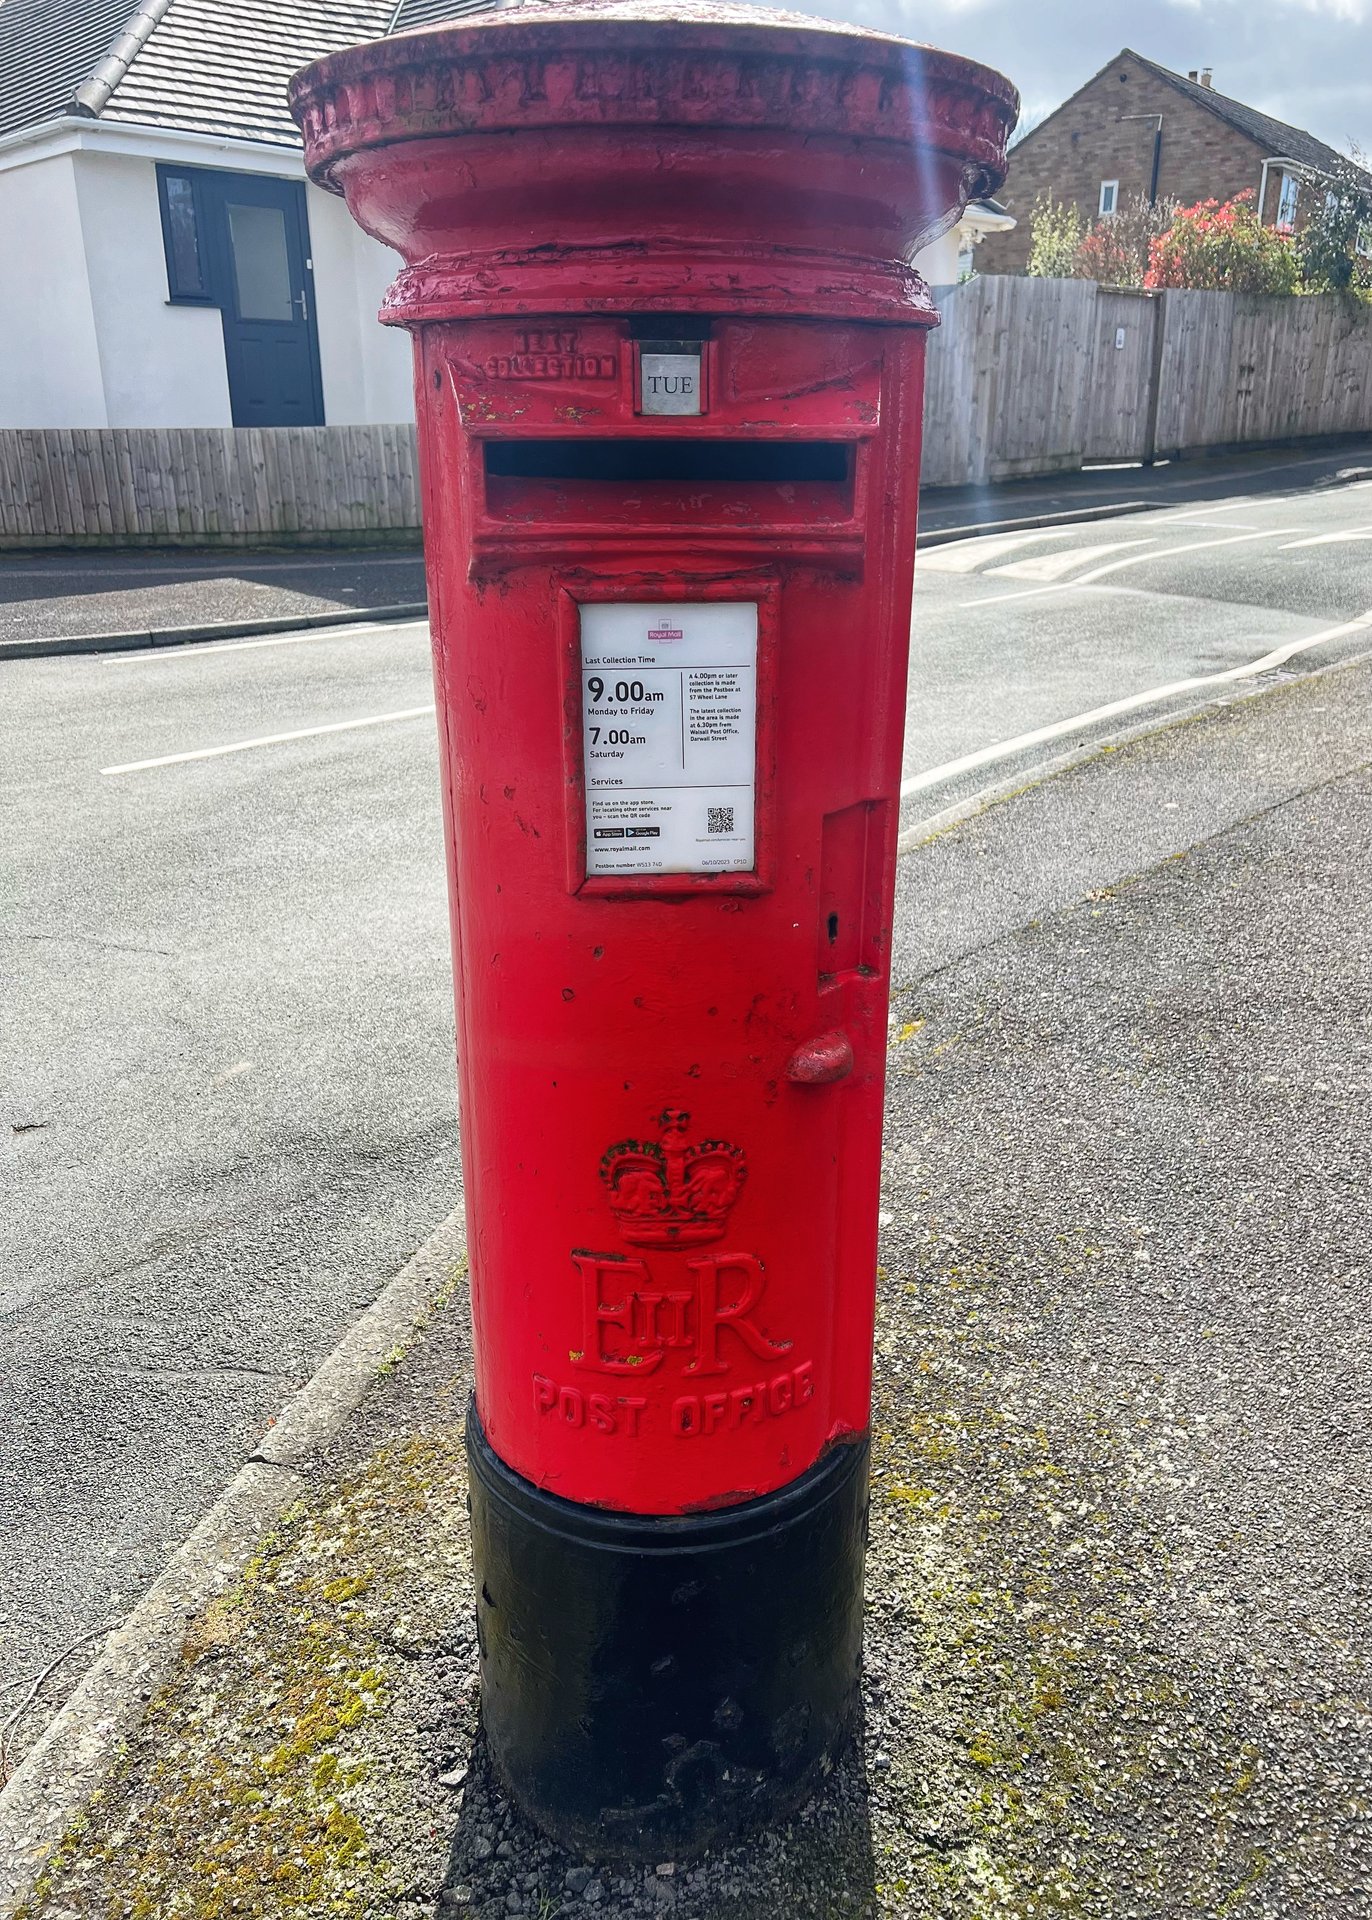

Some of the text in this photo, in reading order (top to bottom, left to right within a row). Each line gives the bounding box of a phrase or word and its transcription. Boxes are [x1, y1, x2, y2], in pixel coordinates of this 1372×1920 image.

[486, 355, 618, 380] COLLECTION
[648, 376, 693, 394] TUE
[587, 677, 664, 703] 9.00am
[588, 708, 618, 716] Monday
[631, 707, 654, 716] Friday
[589, 727, 646, 745] 7.00am
[532, 1360, 815, 1438] POST OFFICE
